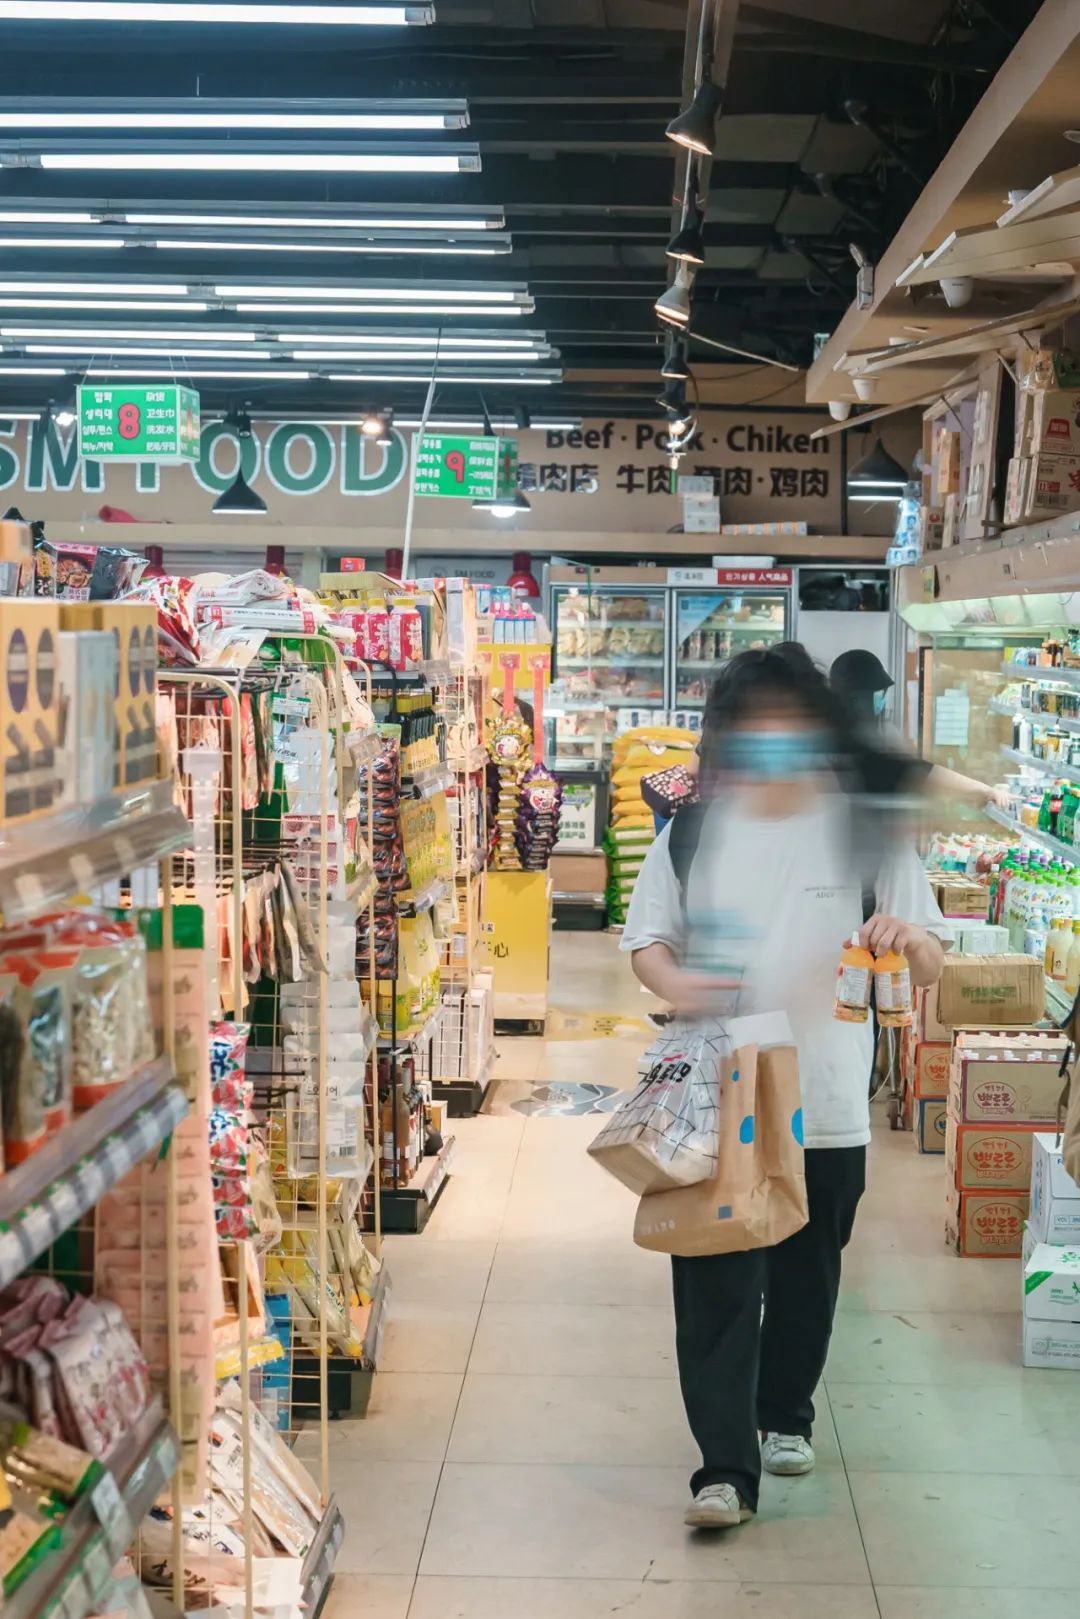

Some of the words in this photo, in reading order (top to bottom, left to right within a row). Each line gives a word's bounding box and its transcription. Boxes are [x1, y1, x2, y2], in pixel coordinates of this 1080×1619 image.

[117, 402, 141, 440] 8
[146, 408, 175, 419] 卫生巾
[546, 421, 615, 449] Beef
[635, 424, 704, 451] Pok
[726, 424, 830, 454] Chiken
[136, 418, 408, 496] OOD
[445, 450, 465, 483] 9
[977, 1092, 1011, 1107] 뽀로로
[973, 1151, 1016, 1169] 뽀로로
[976, 1216, 1019, 1234] 뽀로로
